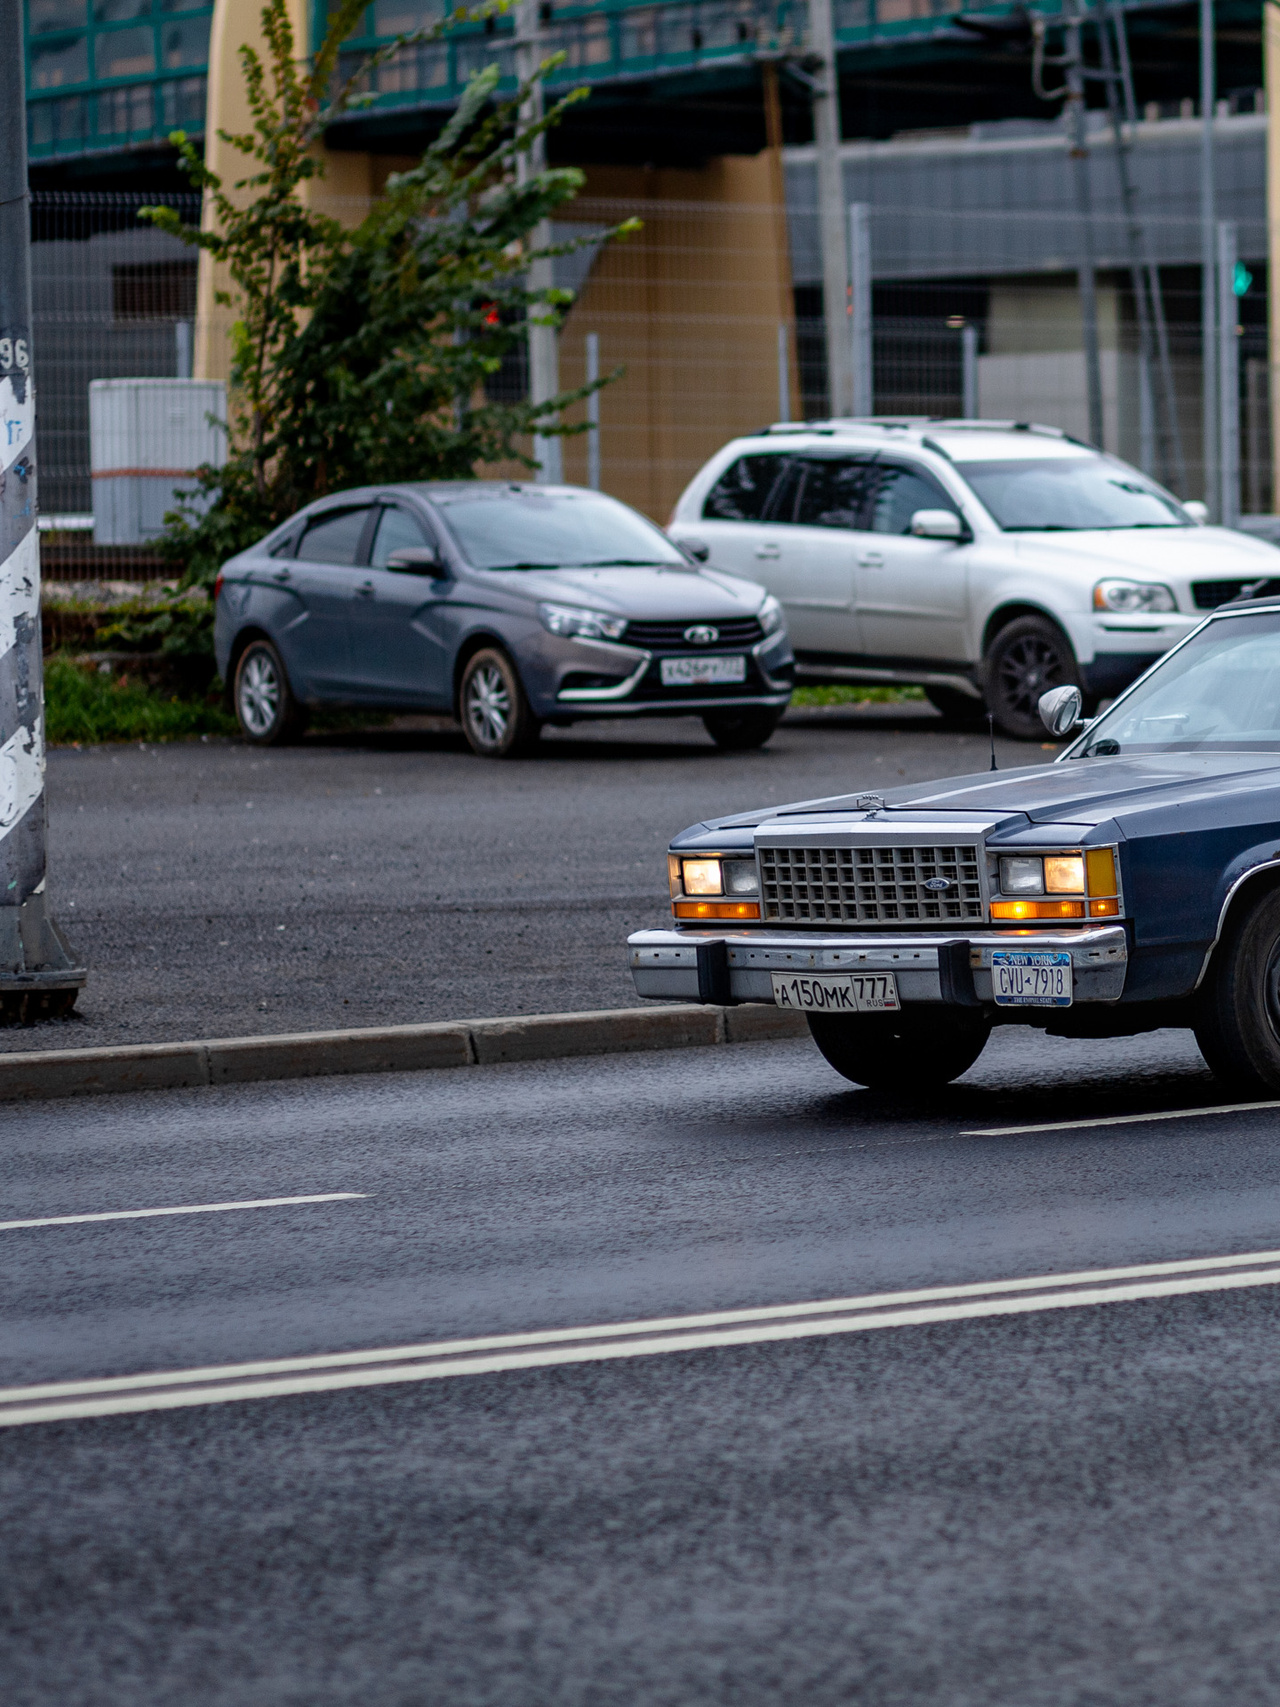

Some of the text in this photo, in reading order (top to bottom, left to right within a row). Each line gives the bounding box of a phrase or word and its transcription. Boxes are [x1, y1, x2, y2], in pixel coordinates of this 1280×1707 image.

[1011, 954, 1053, 966] NEW YORK
[853, 977, 887, 999] 777
[866, 999, 883, 1008] RUS
